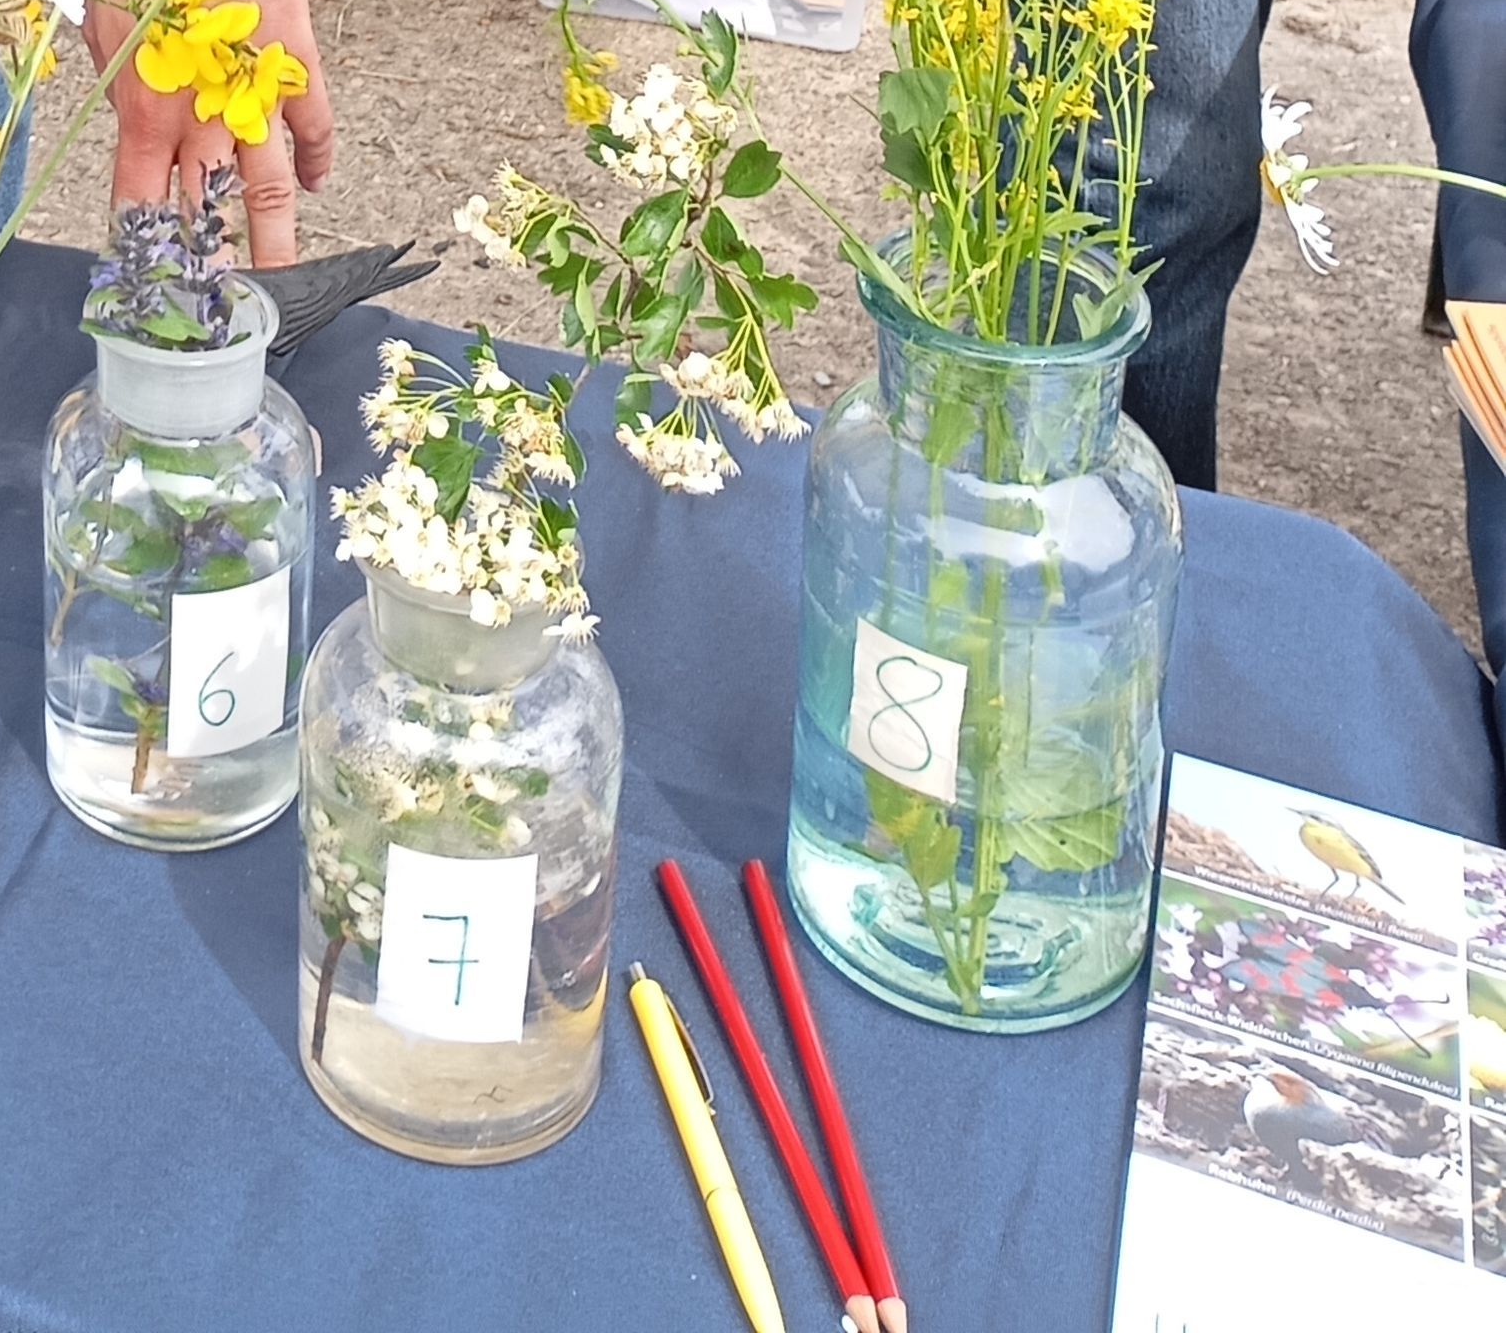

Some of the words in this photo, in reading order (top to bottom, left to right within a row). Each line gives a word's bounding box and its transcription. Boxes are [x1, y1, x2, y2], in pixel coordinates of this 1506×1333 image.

[198, 651, 236, 727] 6
[867, 655, 943, 772] 8
[422, 914, 480, 1006] 7
